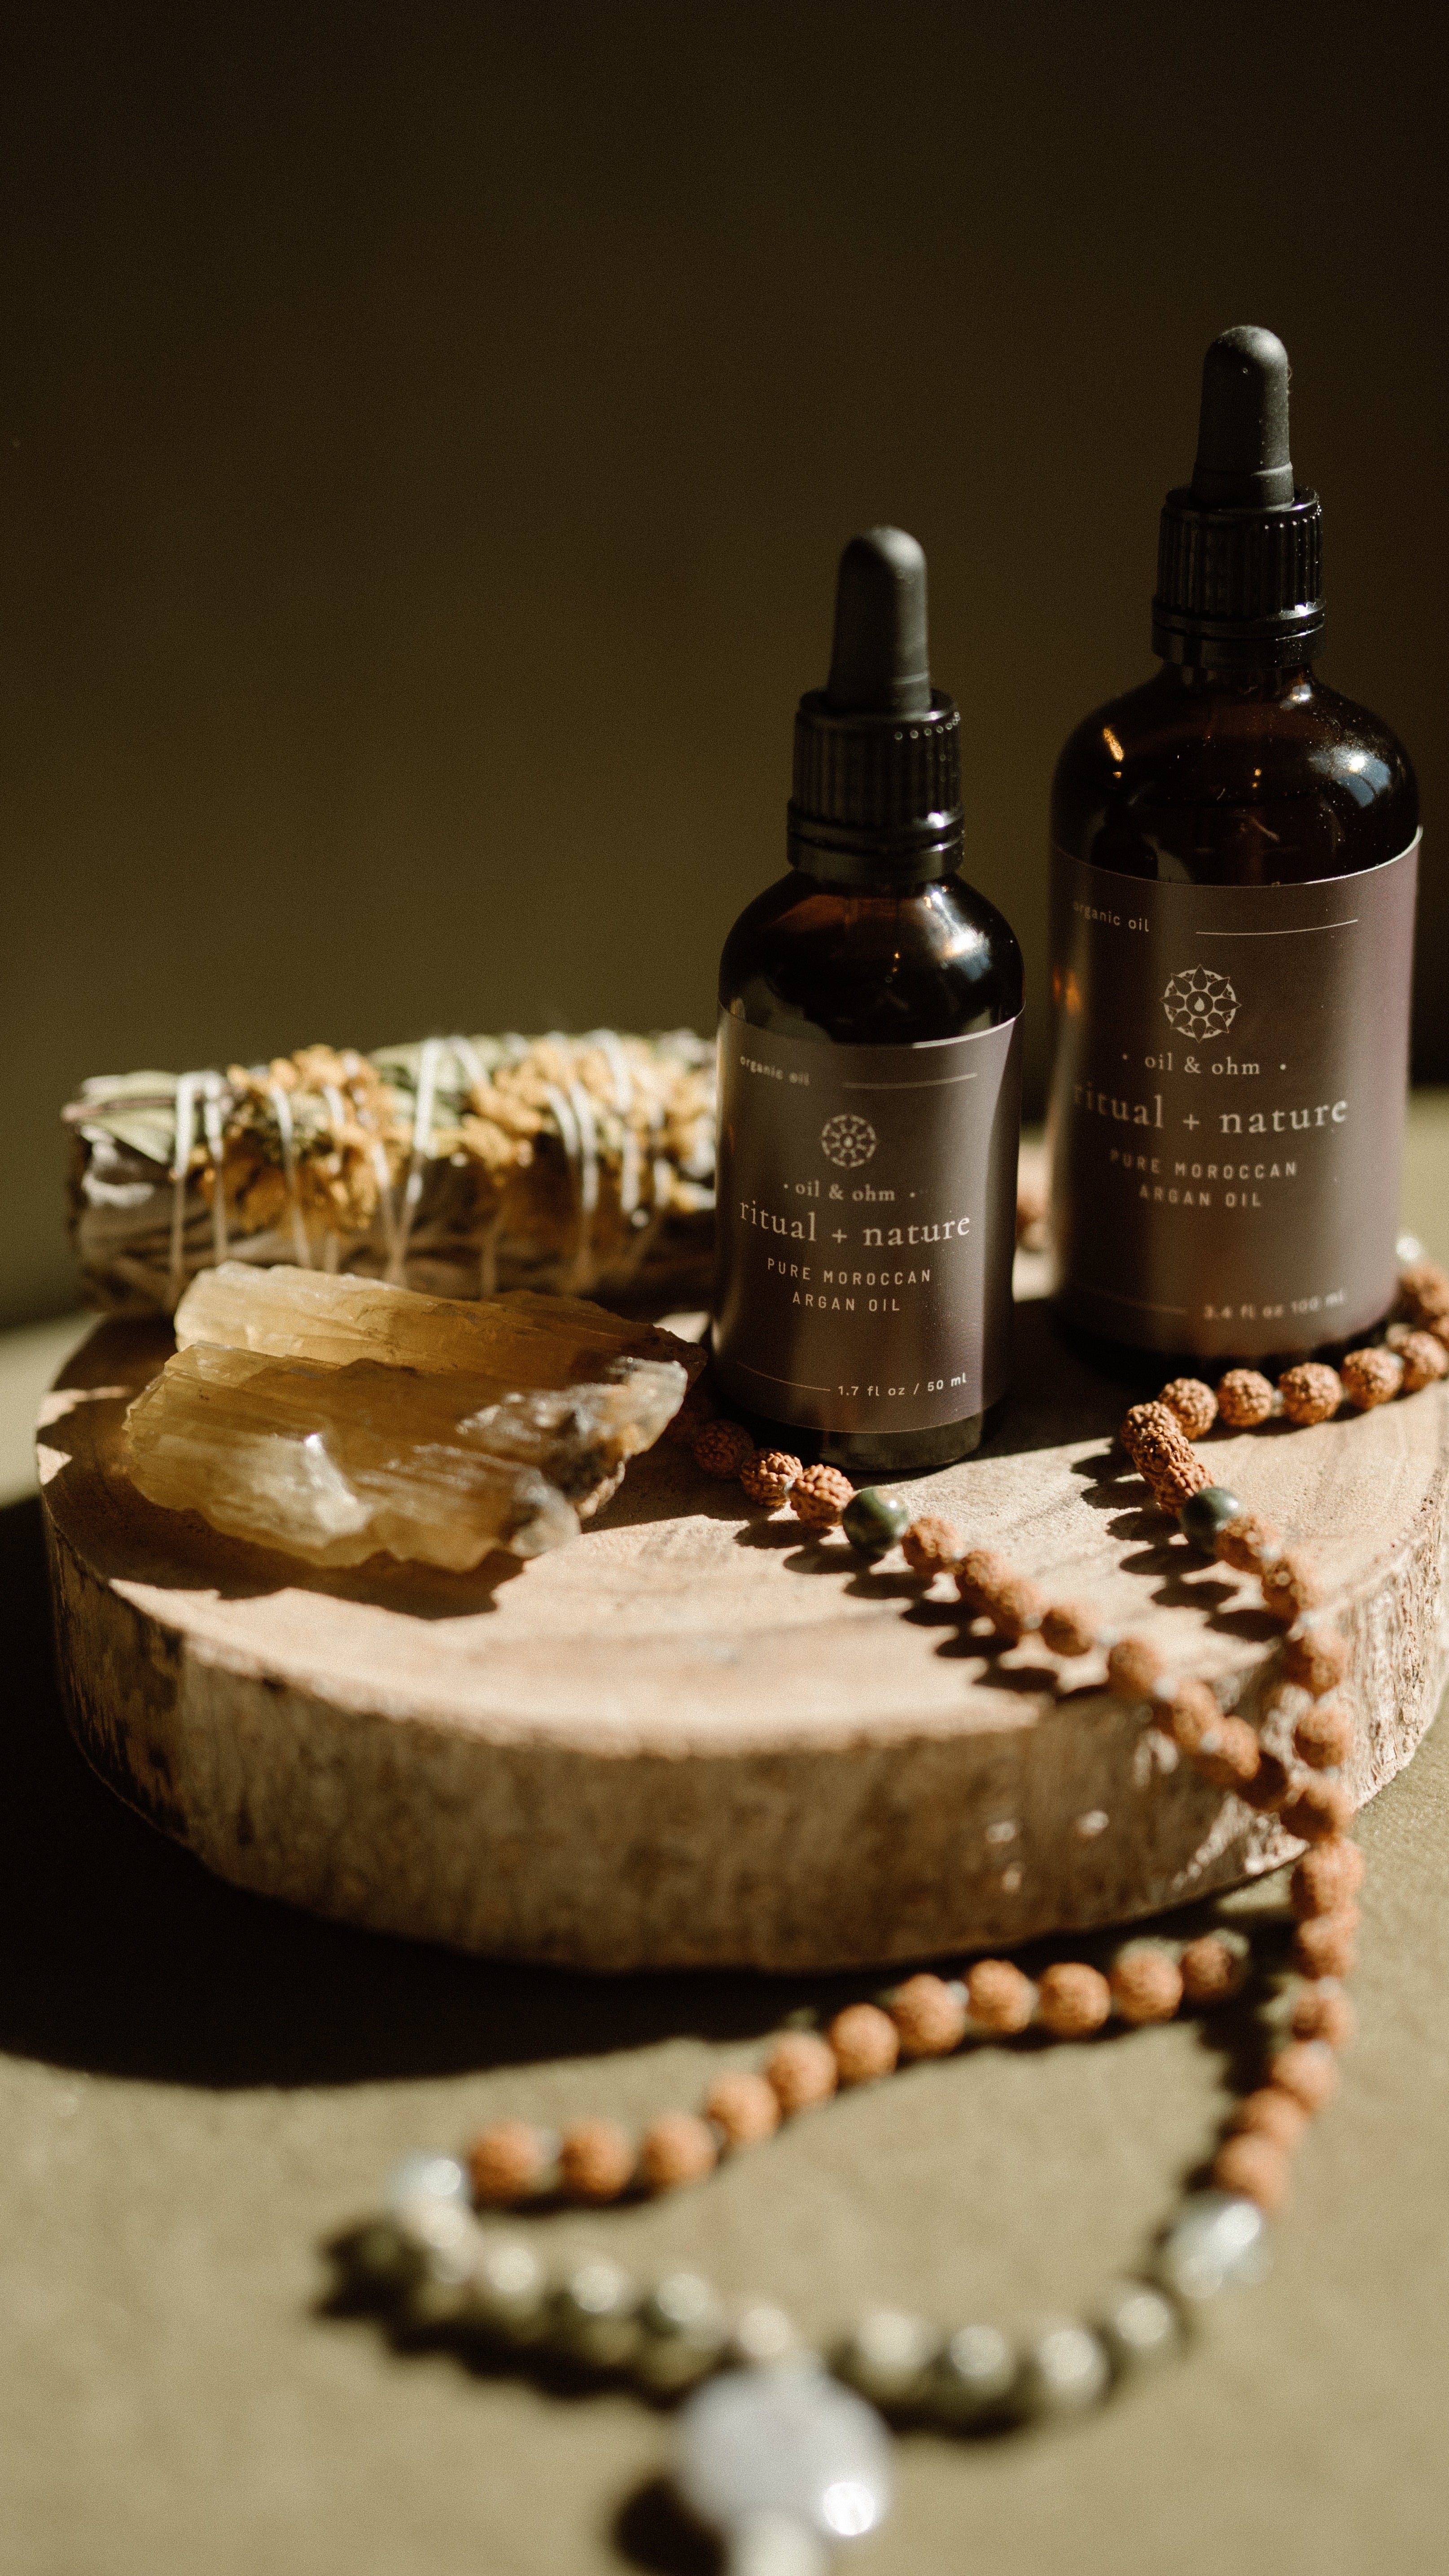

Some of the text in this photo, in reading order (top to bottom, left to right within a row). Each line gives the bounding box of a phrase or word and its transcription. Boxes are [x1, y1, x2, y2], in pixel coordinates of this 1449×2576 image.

[1128, 918, 1149, 932] oil
[740, 1056, 810, 1086] organic oil
[1145, 1053, 1260, 1075] oil & ohm
[1183, 1114, 1199, 1130] +
[1219, 1100, 1347, 1133] nature
[1110, 1149, 1297, 1179] PURE MOROCCAN
[796, 1180, 895, 1202] oil & ohm
[1140, 1184, 1261, 1207] ARGAN OIL
[740, 1200, 971, 1246] ritual + nature
[768, 1258, 930, 1286] PURE MOROCCAN
[792, 1291, 900, 1312] ARGAN OIL
[838, 1372, 967, 1396] 1.7 fl oz / 50 ml
